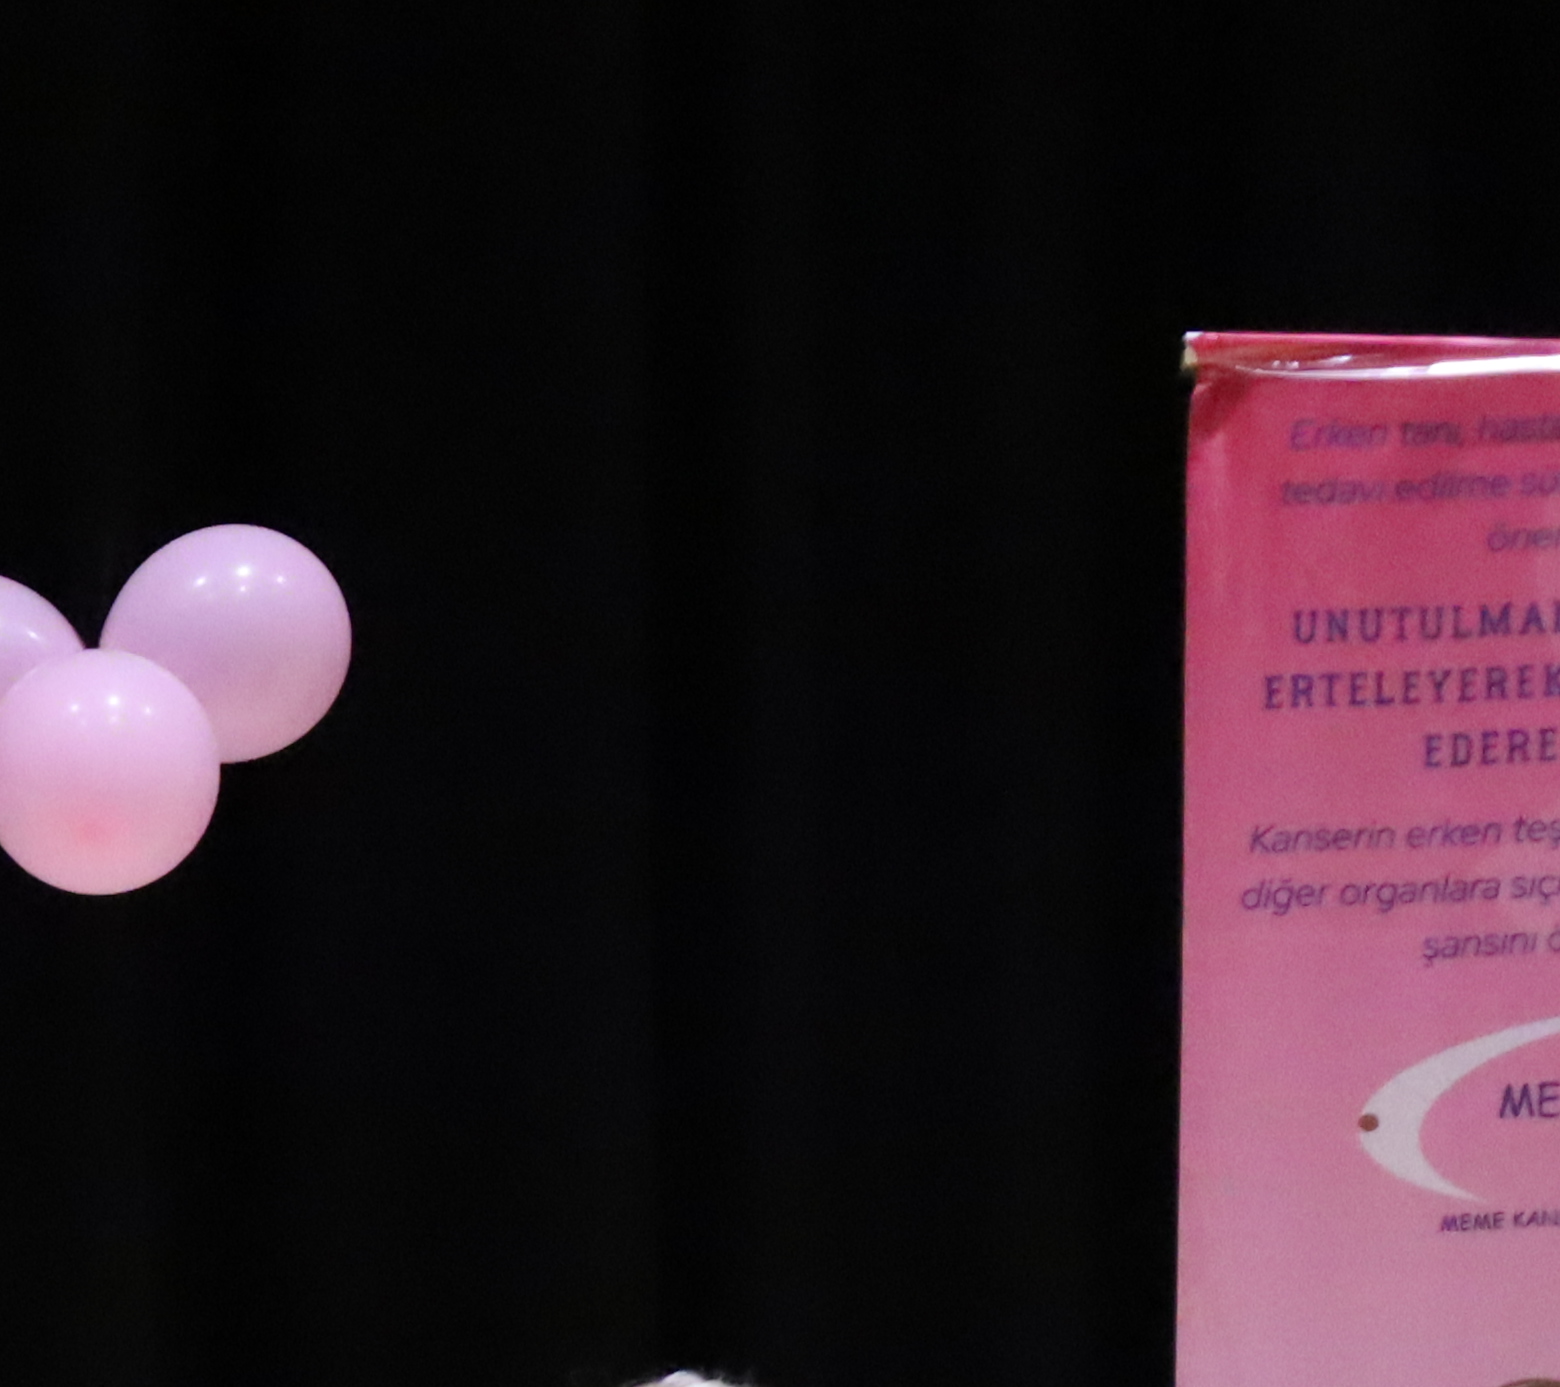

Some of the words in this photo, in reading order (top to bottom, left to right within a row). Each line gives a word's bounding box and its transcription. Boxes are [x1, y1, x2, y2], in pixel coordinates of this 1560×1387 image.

[1248, 823, 1398, 853] Kanserin
[1406, 821, 1504, 849] erken
[1241, 878, 1329, 915] diğer
[1338, 873, 1502, 913] organlara
[1422, 930, 1538, 967] şansını
[1499, 1081, 1560, 1119] ME
[1440, 1211, 1504, 1232] MEME
